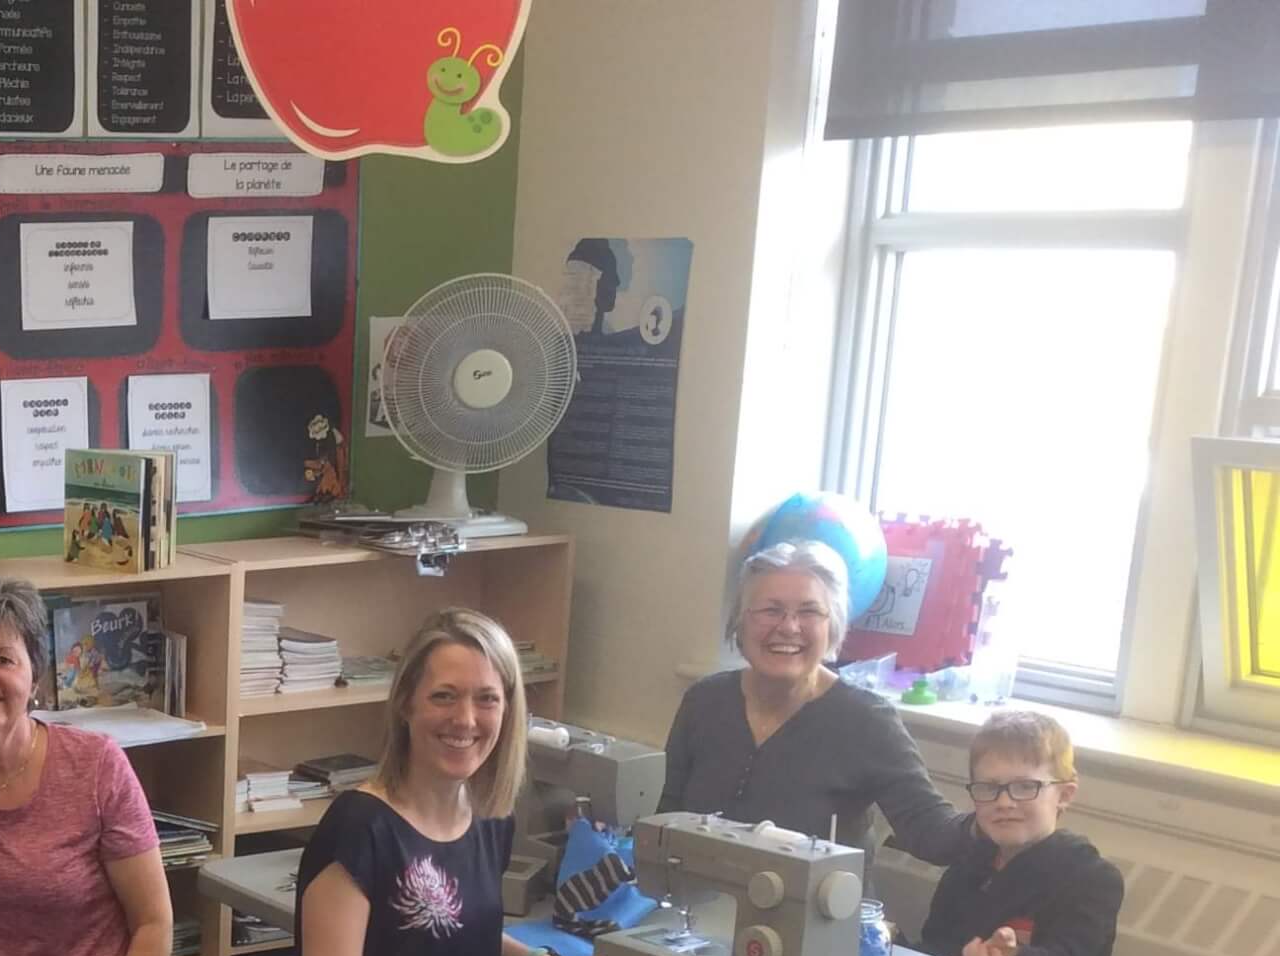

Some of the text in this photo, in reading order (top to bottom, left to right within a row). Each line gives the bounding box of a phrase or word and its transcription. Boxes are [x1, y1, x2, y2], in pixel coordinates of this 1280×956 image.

[35, 163, 54, 177] Une
[57, 163, 87, 176] faune
[223, 158, 293, 175] Le partage de
[235, 179, 246, 190] la
